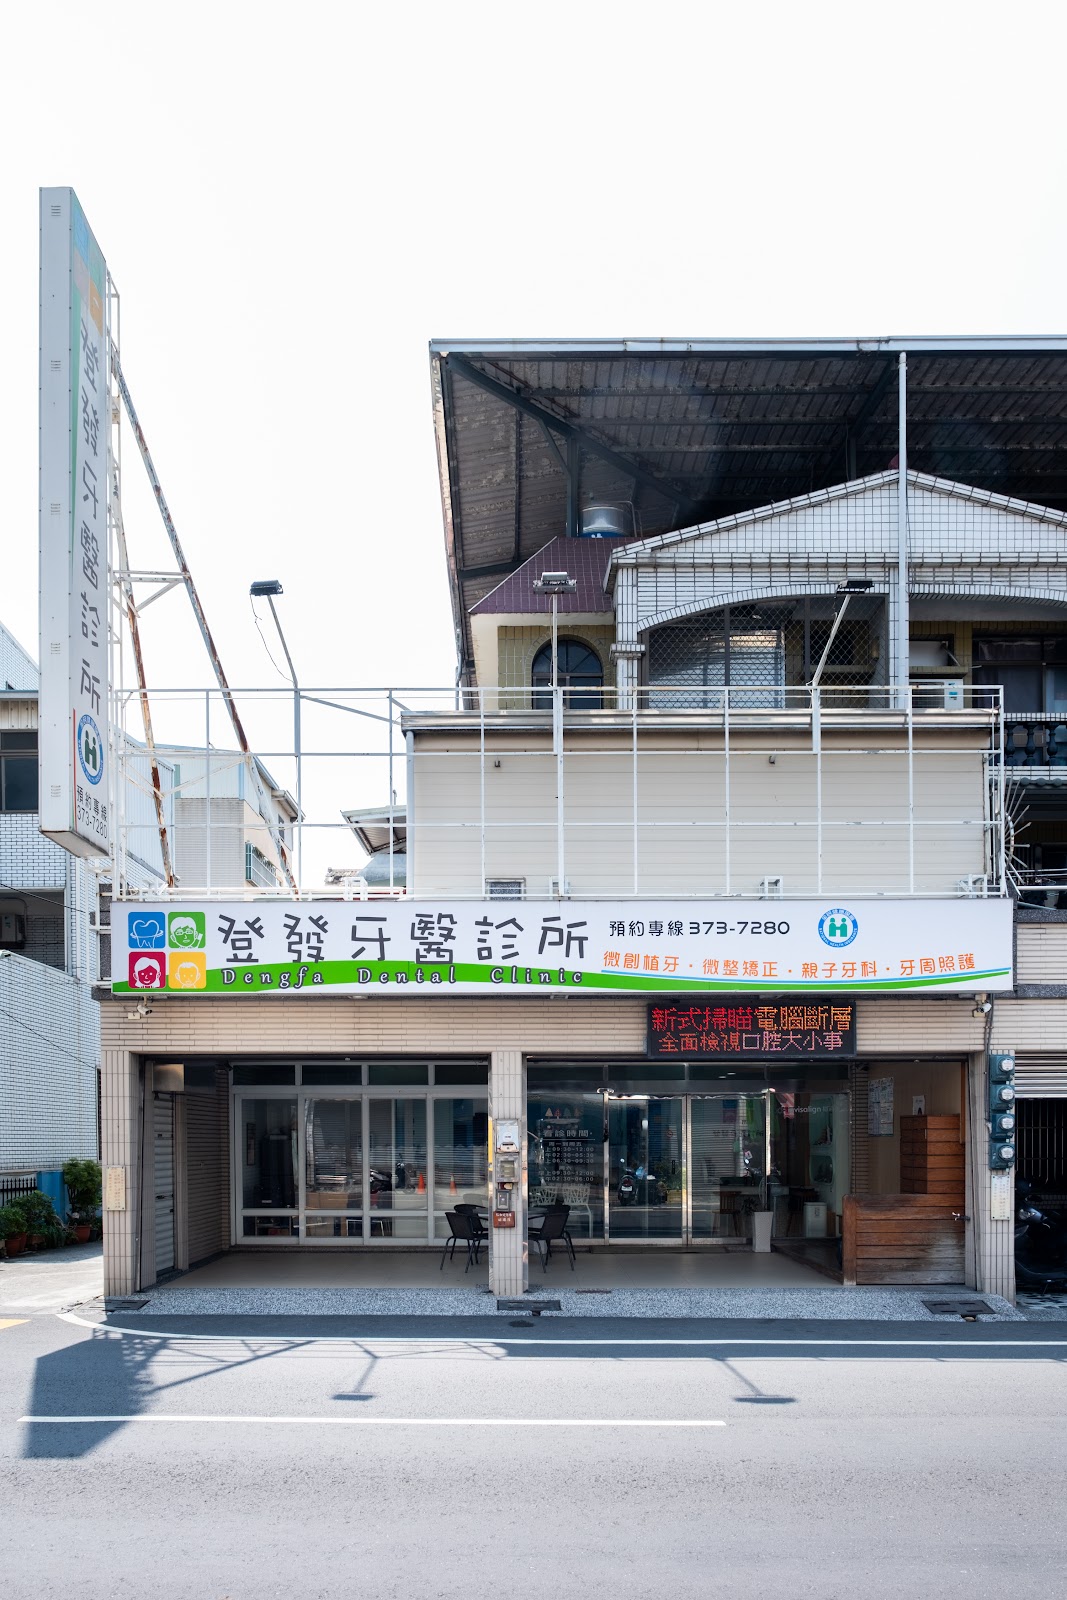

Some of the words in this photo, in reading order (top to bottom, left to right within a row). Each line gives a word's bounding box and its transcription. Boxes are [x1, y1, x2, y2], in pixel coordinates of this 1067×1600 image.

[76, 804, 107, 839] 373-7280
[217, 913, 589, 965] 登發牙醫診所
[609, 920, 685, 937] 預約專線
[689, 921, 790, 935] 373-7280
[221, 965, 325, 990] Dengfa
[357, 965, 456, 984] Dental
[490, 966, 583, 984] Clinic
